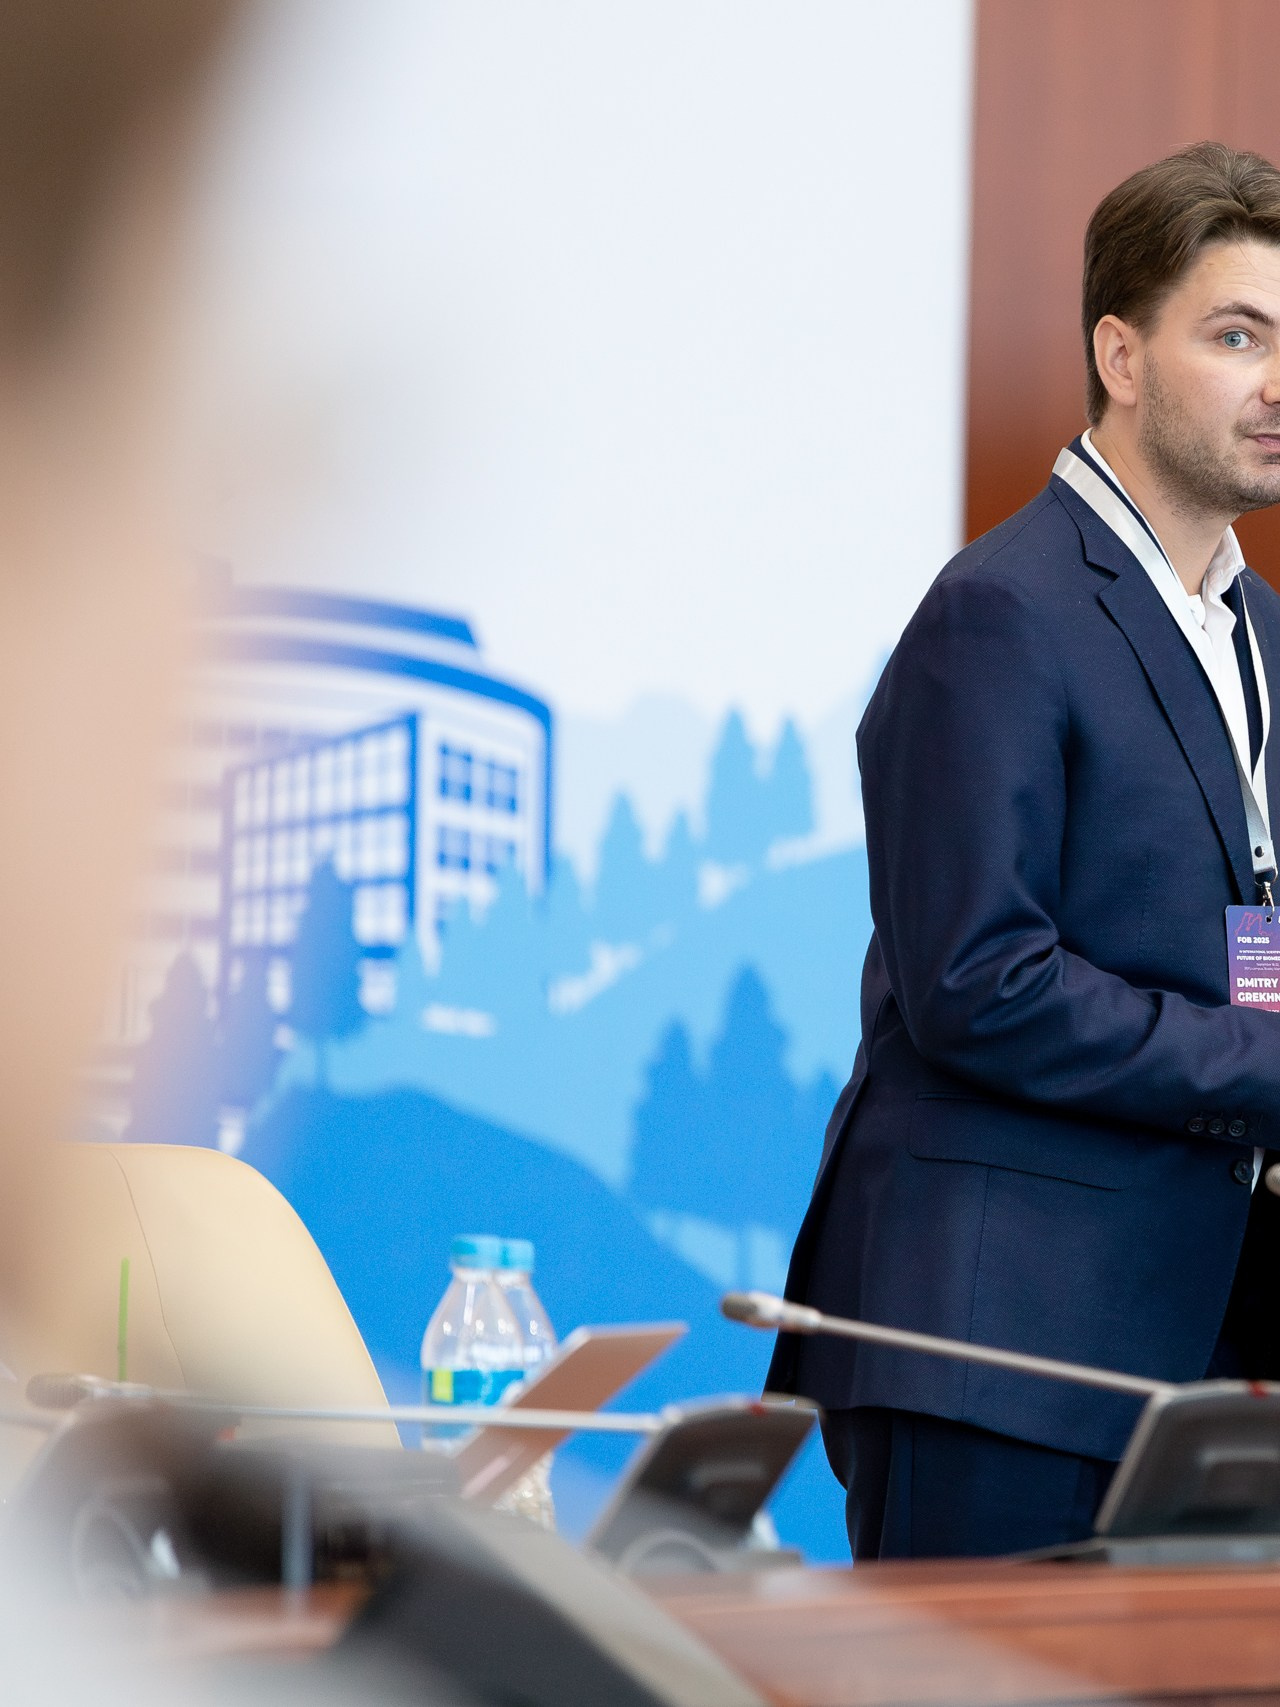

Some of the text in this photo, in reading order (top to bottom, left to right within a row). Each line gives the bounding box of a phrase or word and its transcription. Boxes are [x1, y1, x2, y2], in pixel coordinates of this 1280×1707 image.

[1237, 936, 1270, 944] FOB 2025
[1236, 978, 1278, 988] DMITRY
